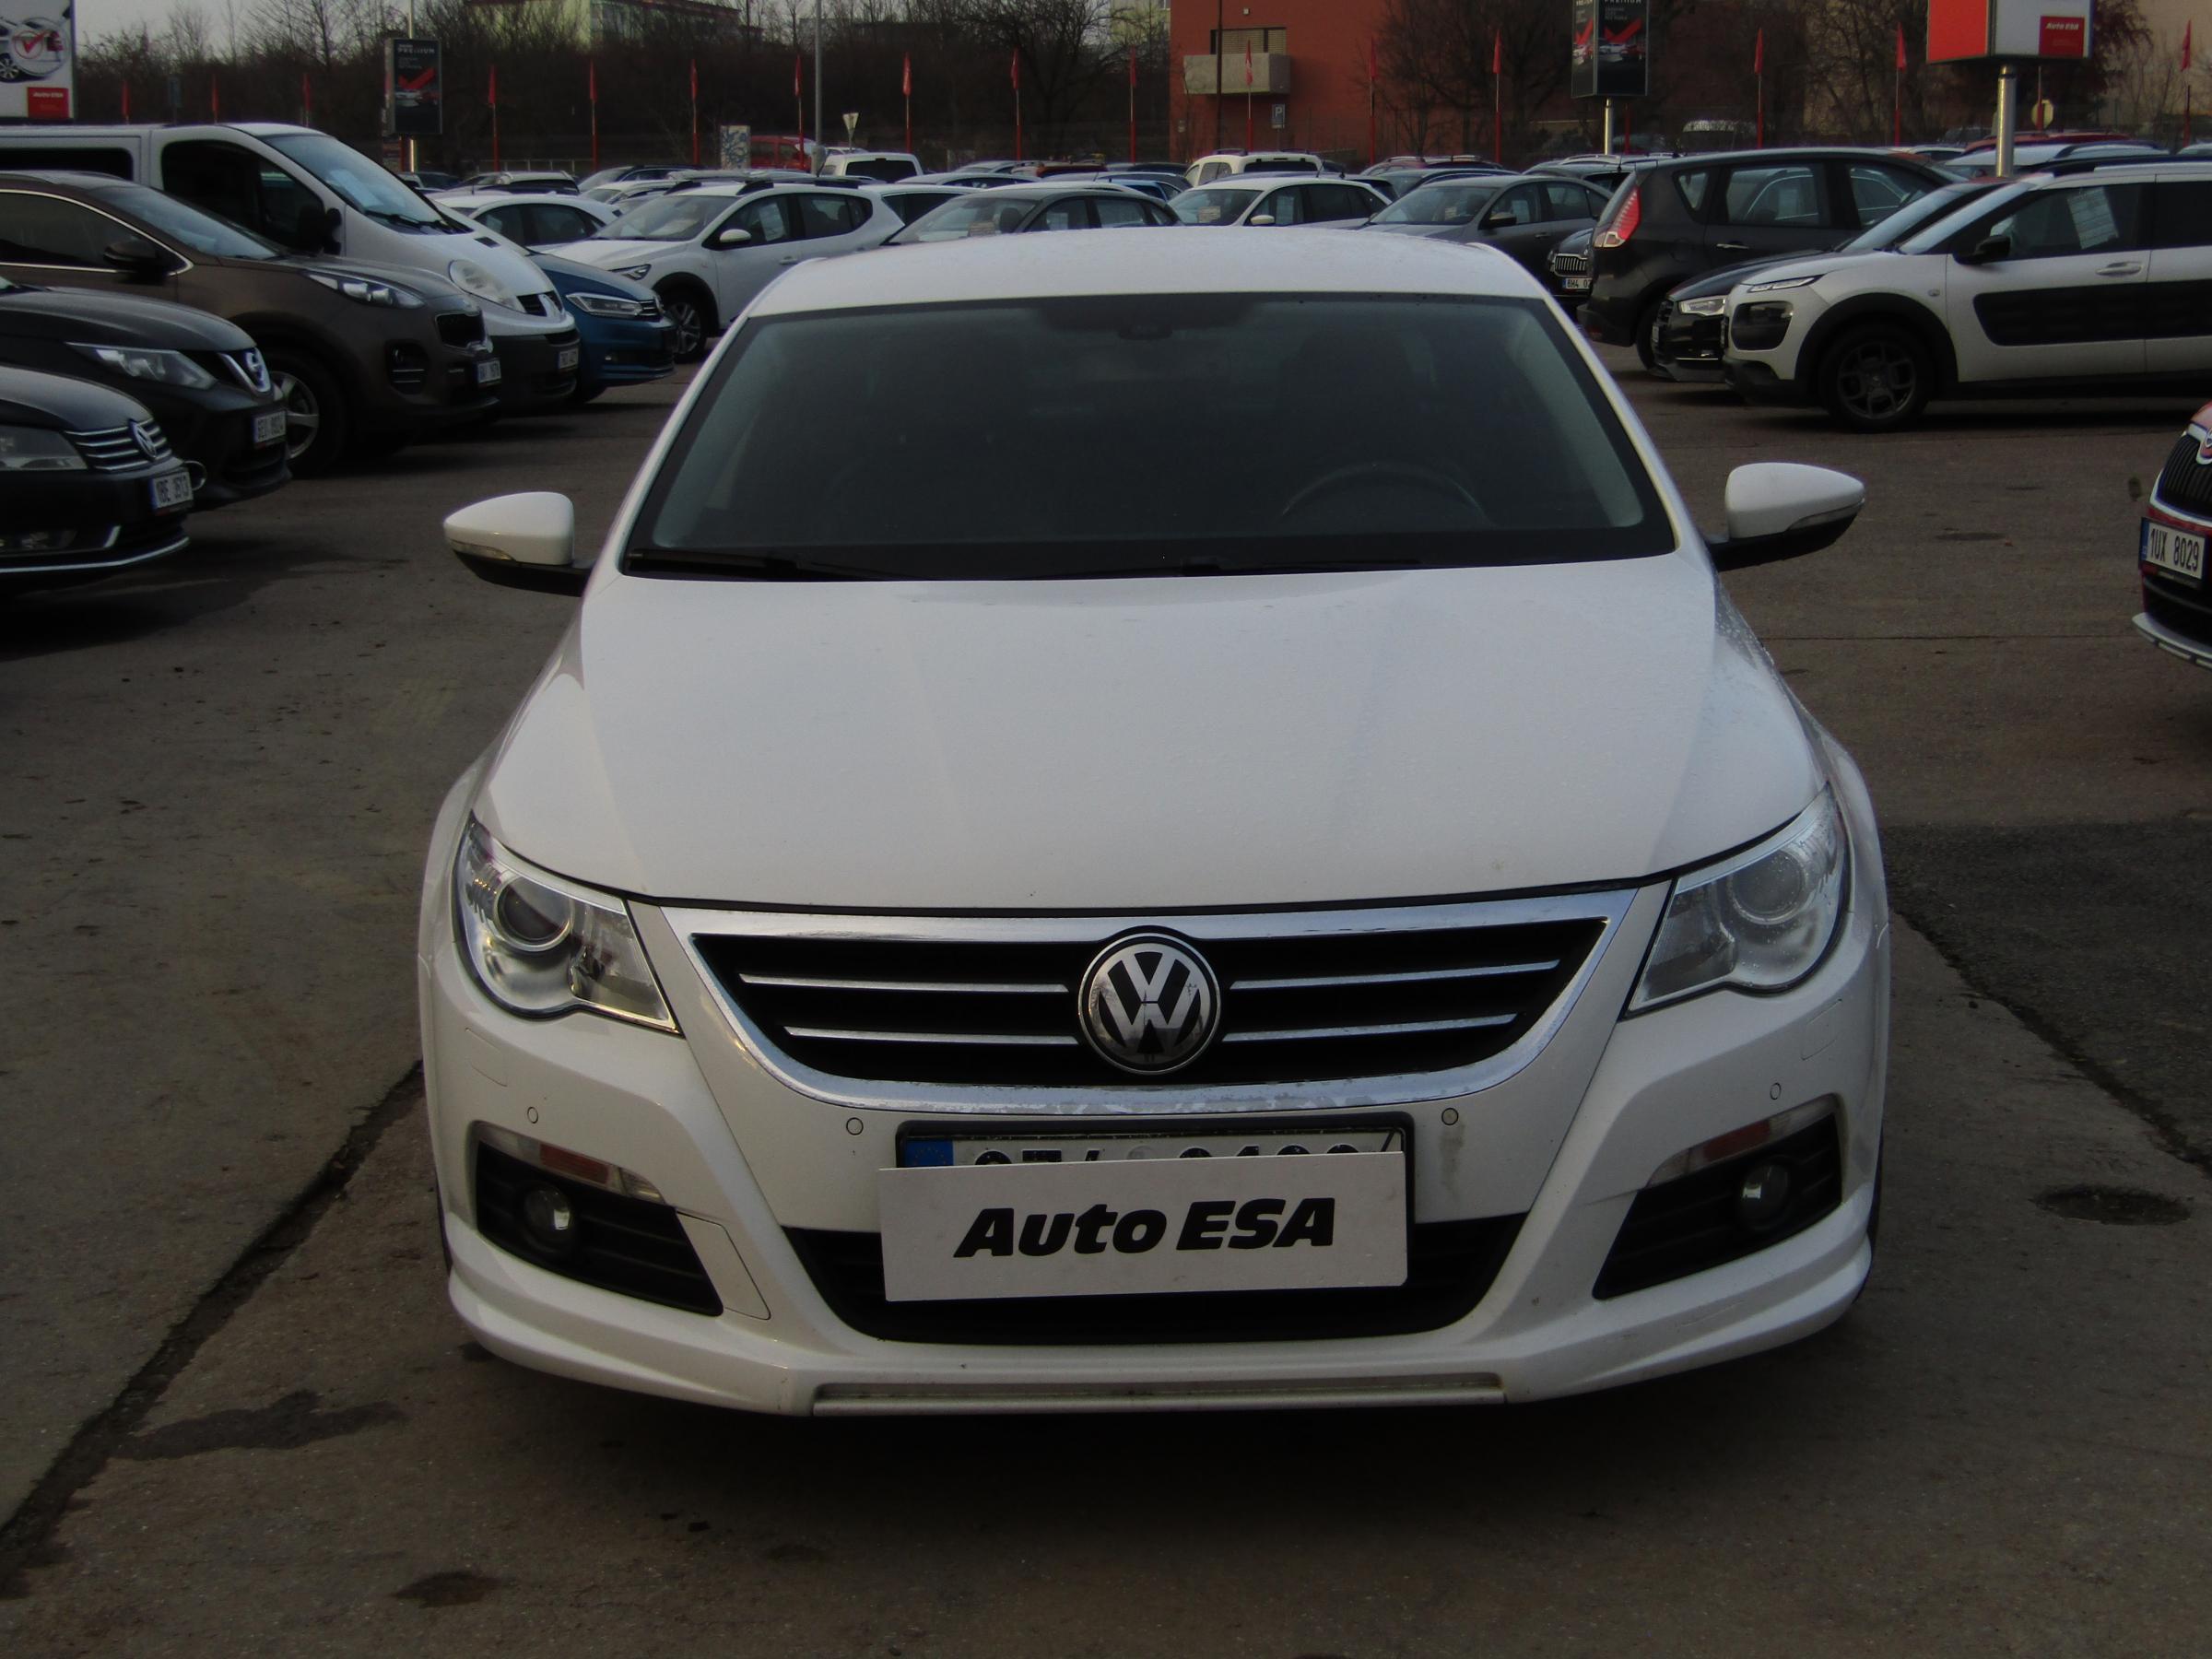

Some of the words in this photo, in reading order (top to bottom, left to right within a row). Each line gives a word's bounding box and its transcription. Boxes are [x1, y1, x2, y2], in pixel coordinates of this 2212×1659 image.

[1275, 106, 1283, 117] P
[2150, 527, 2169, 562] 1UX
[2173, 535, 2200, 572] 8029
[1088, 943, 1211, 1065] VW
[952, 1204, 1168, 1258] Auto
[1176, 1197, 1335, 1251] ESA
